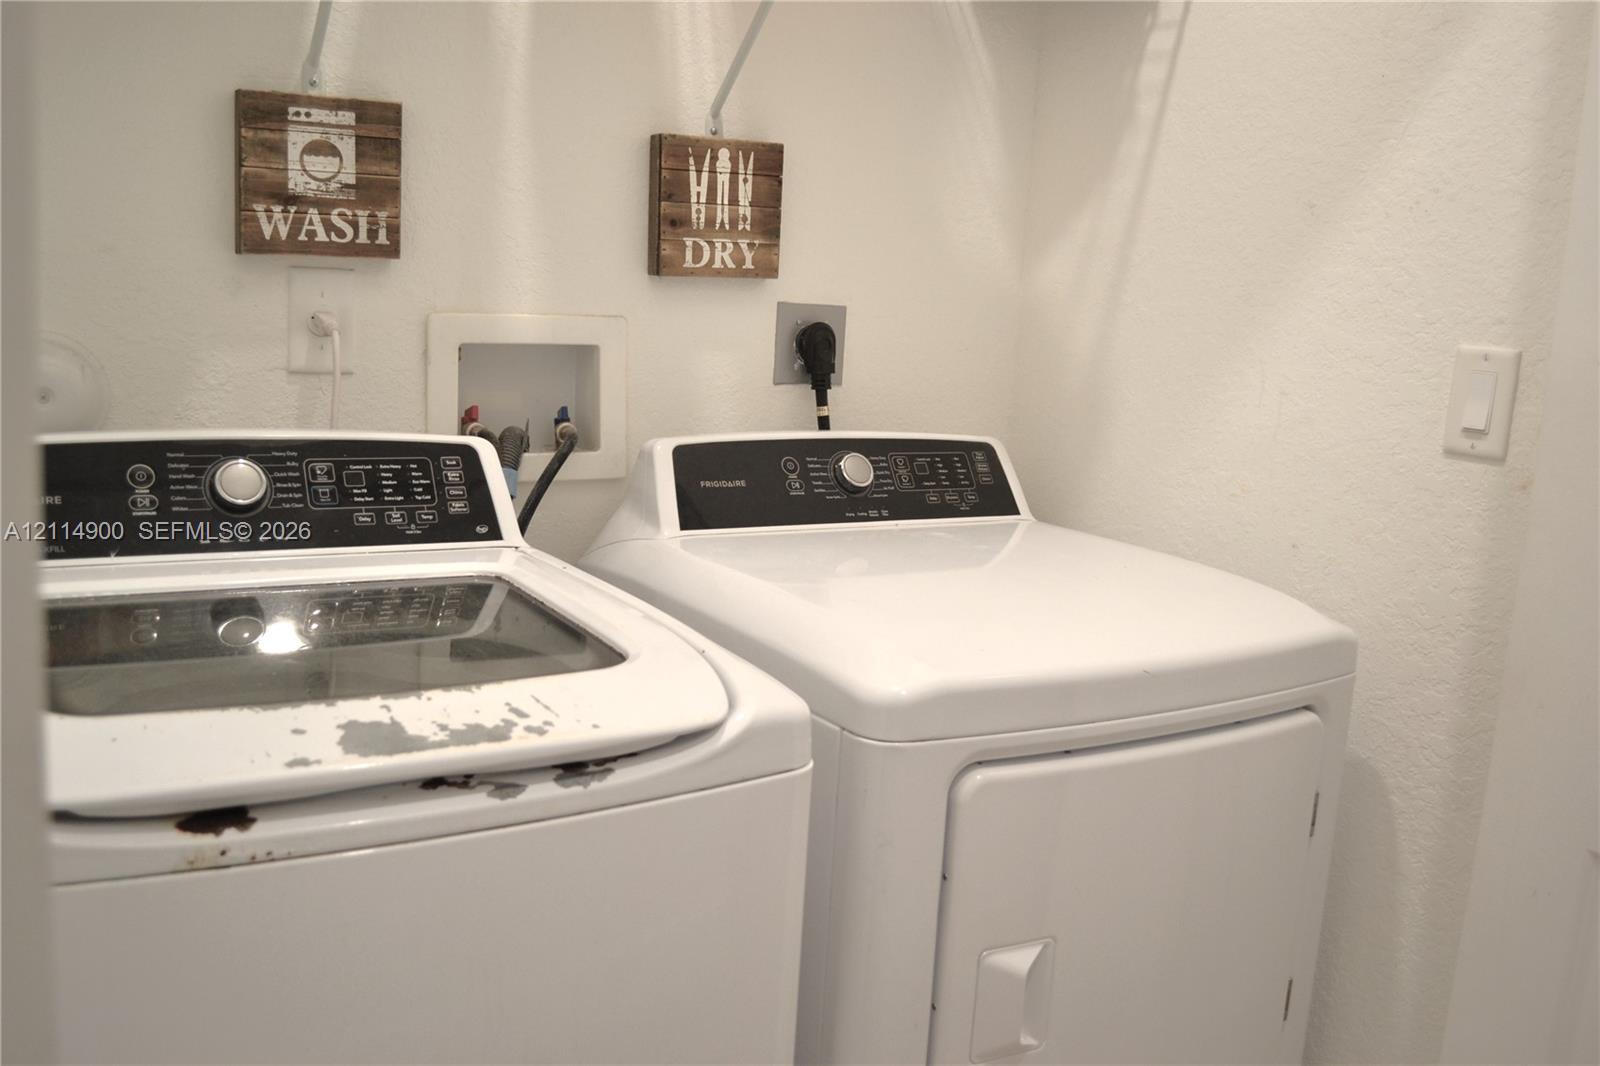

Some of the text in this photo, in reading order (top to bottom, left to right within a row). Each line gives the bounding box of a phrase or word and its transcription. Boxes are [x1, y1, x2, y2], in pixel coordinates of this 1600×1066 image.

[252, 203, 390, 245] WASH
[682, 237, 760, 269] DRY
[700, 480, 747, 488] FRIGIDAIRE
